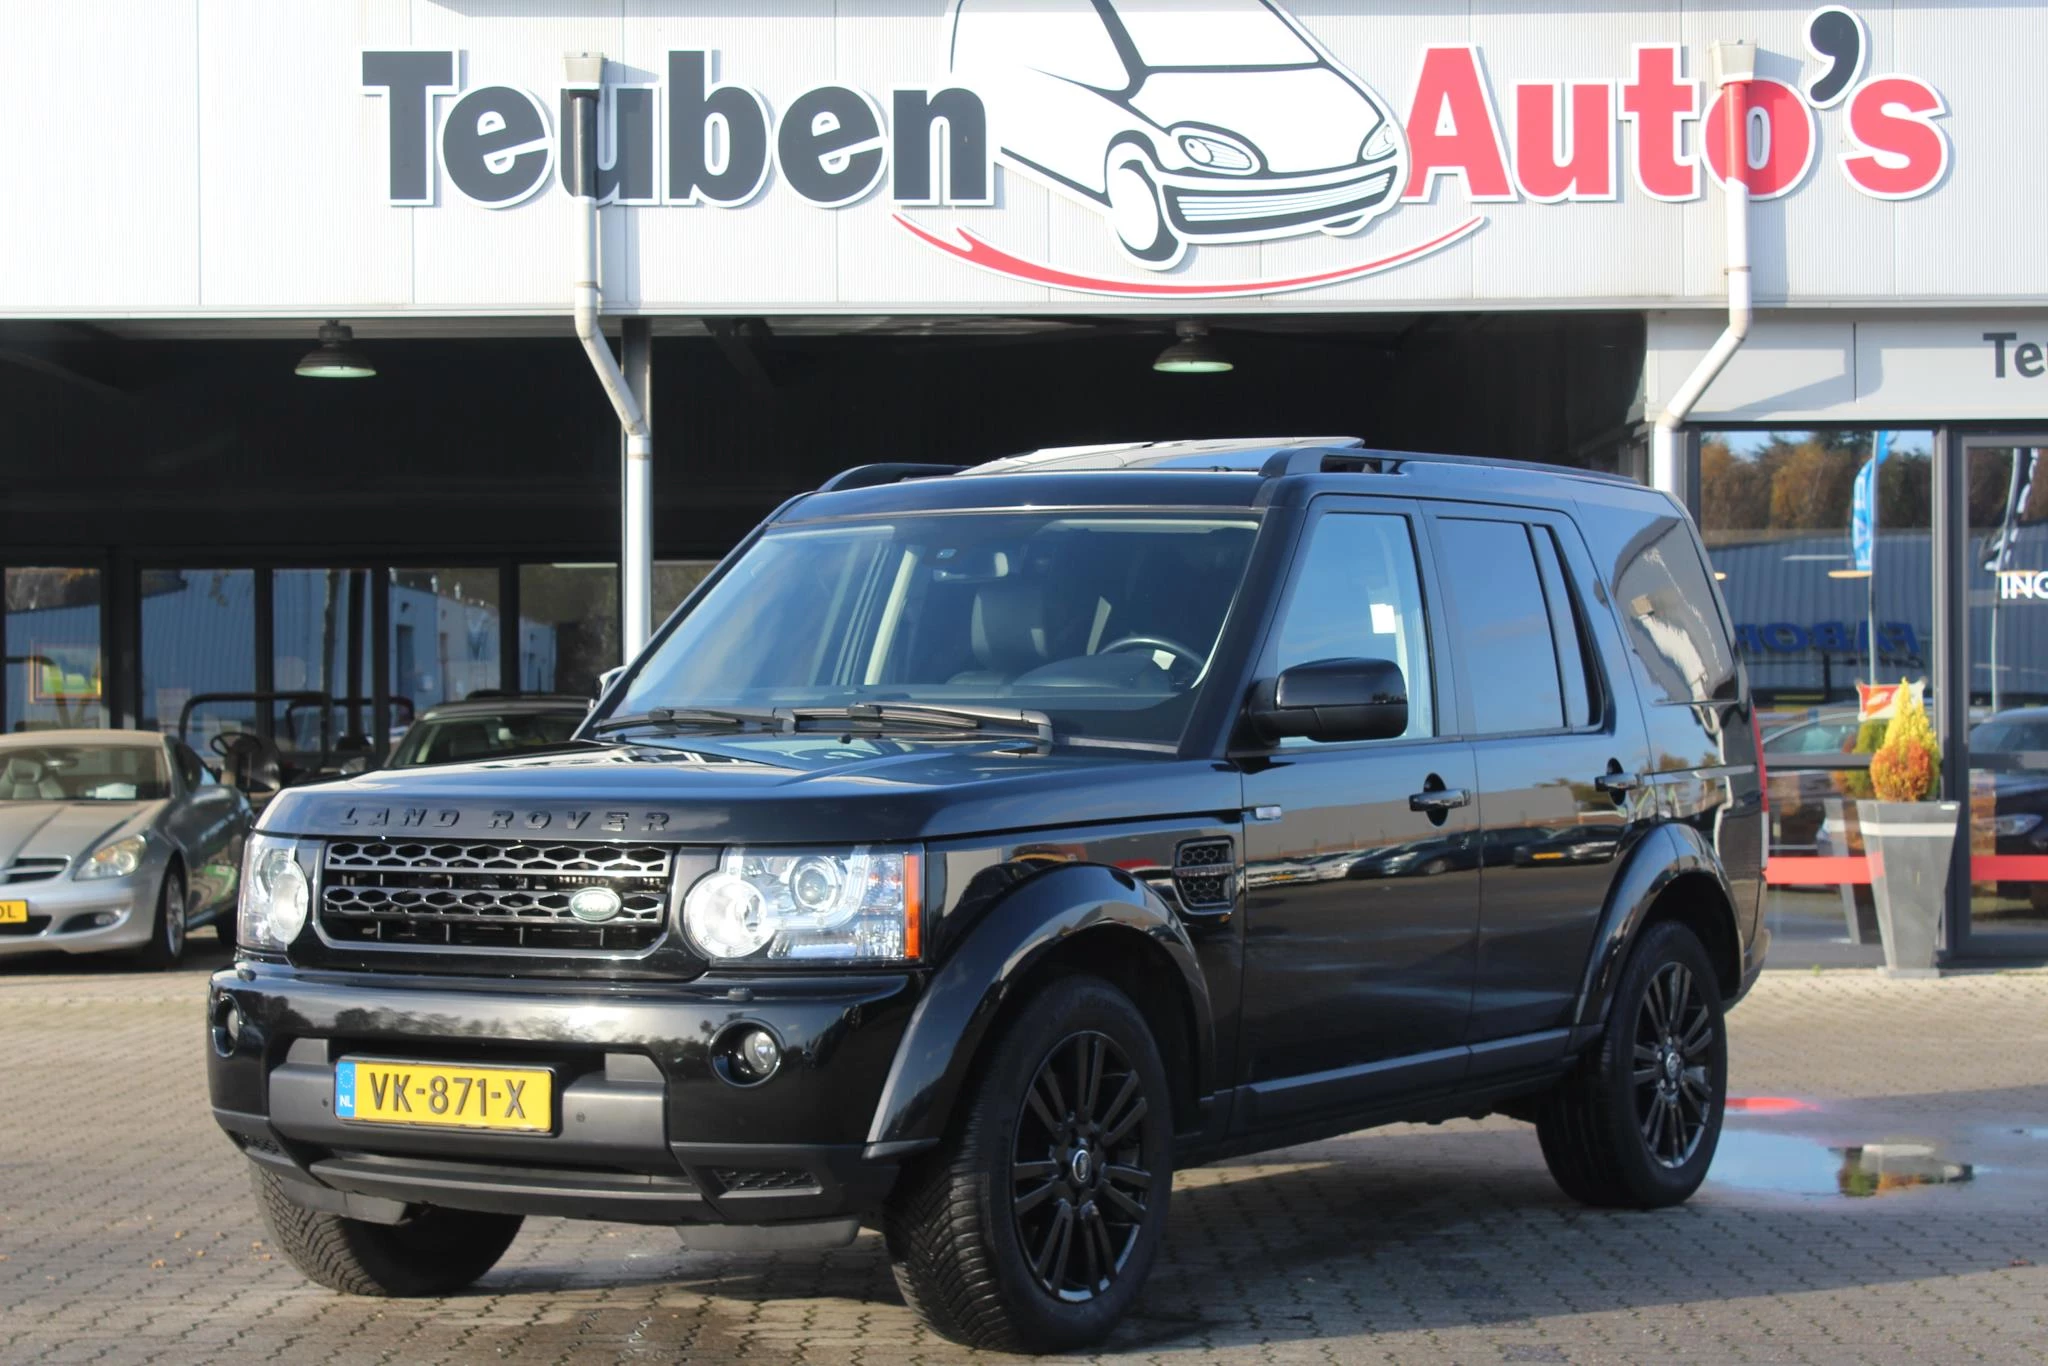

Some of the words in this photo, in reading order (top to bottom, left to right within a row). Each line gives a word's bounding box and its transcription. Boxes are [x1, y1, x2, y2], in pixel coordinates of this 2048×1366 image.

[361, 49, 988, 207] Teuben
[1403, 11, 1948, 200] Auto's
[1983, 332, 2048, 378] Te
[339, 807, 461, 828] LAND
[487, 809, 672, 833] ROVER
[338, 1094, 353, 1108] NL
[369, 1072, 526, 1119] VK-871-X
